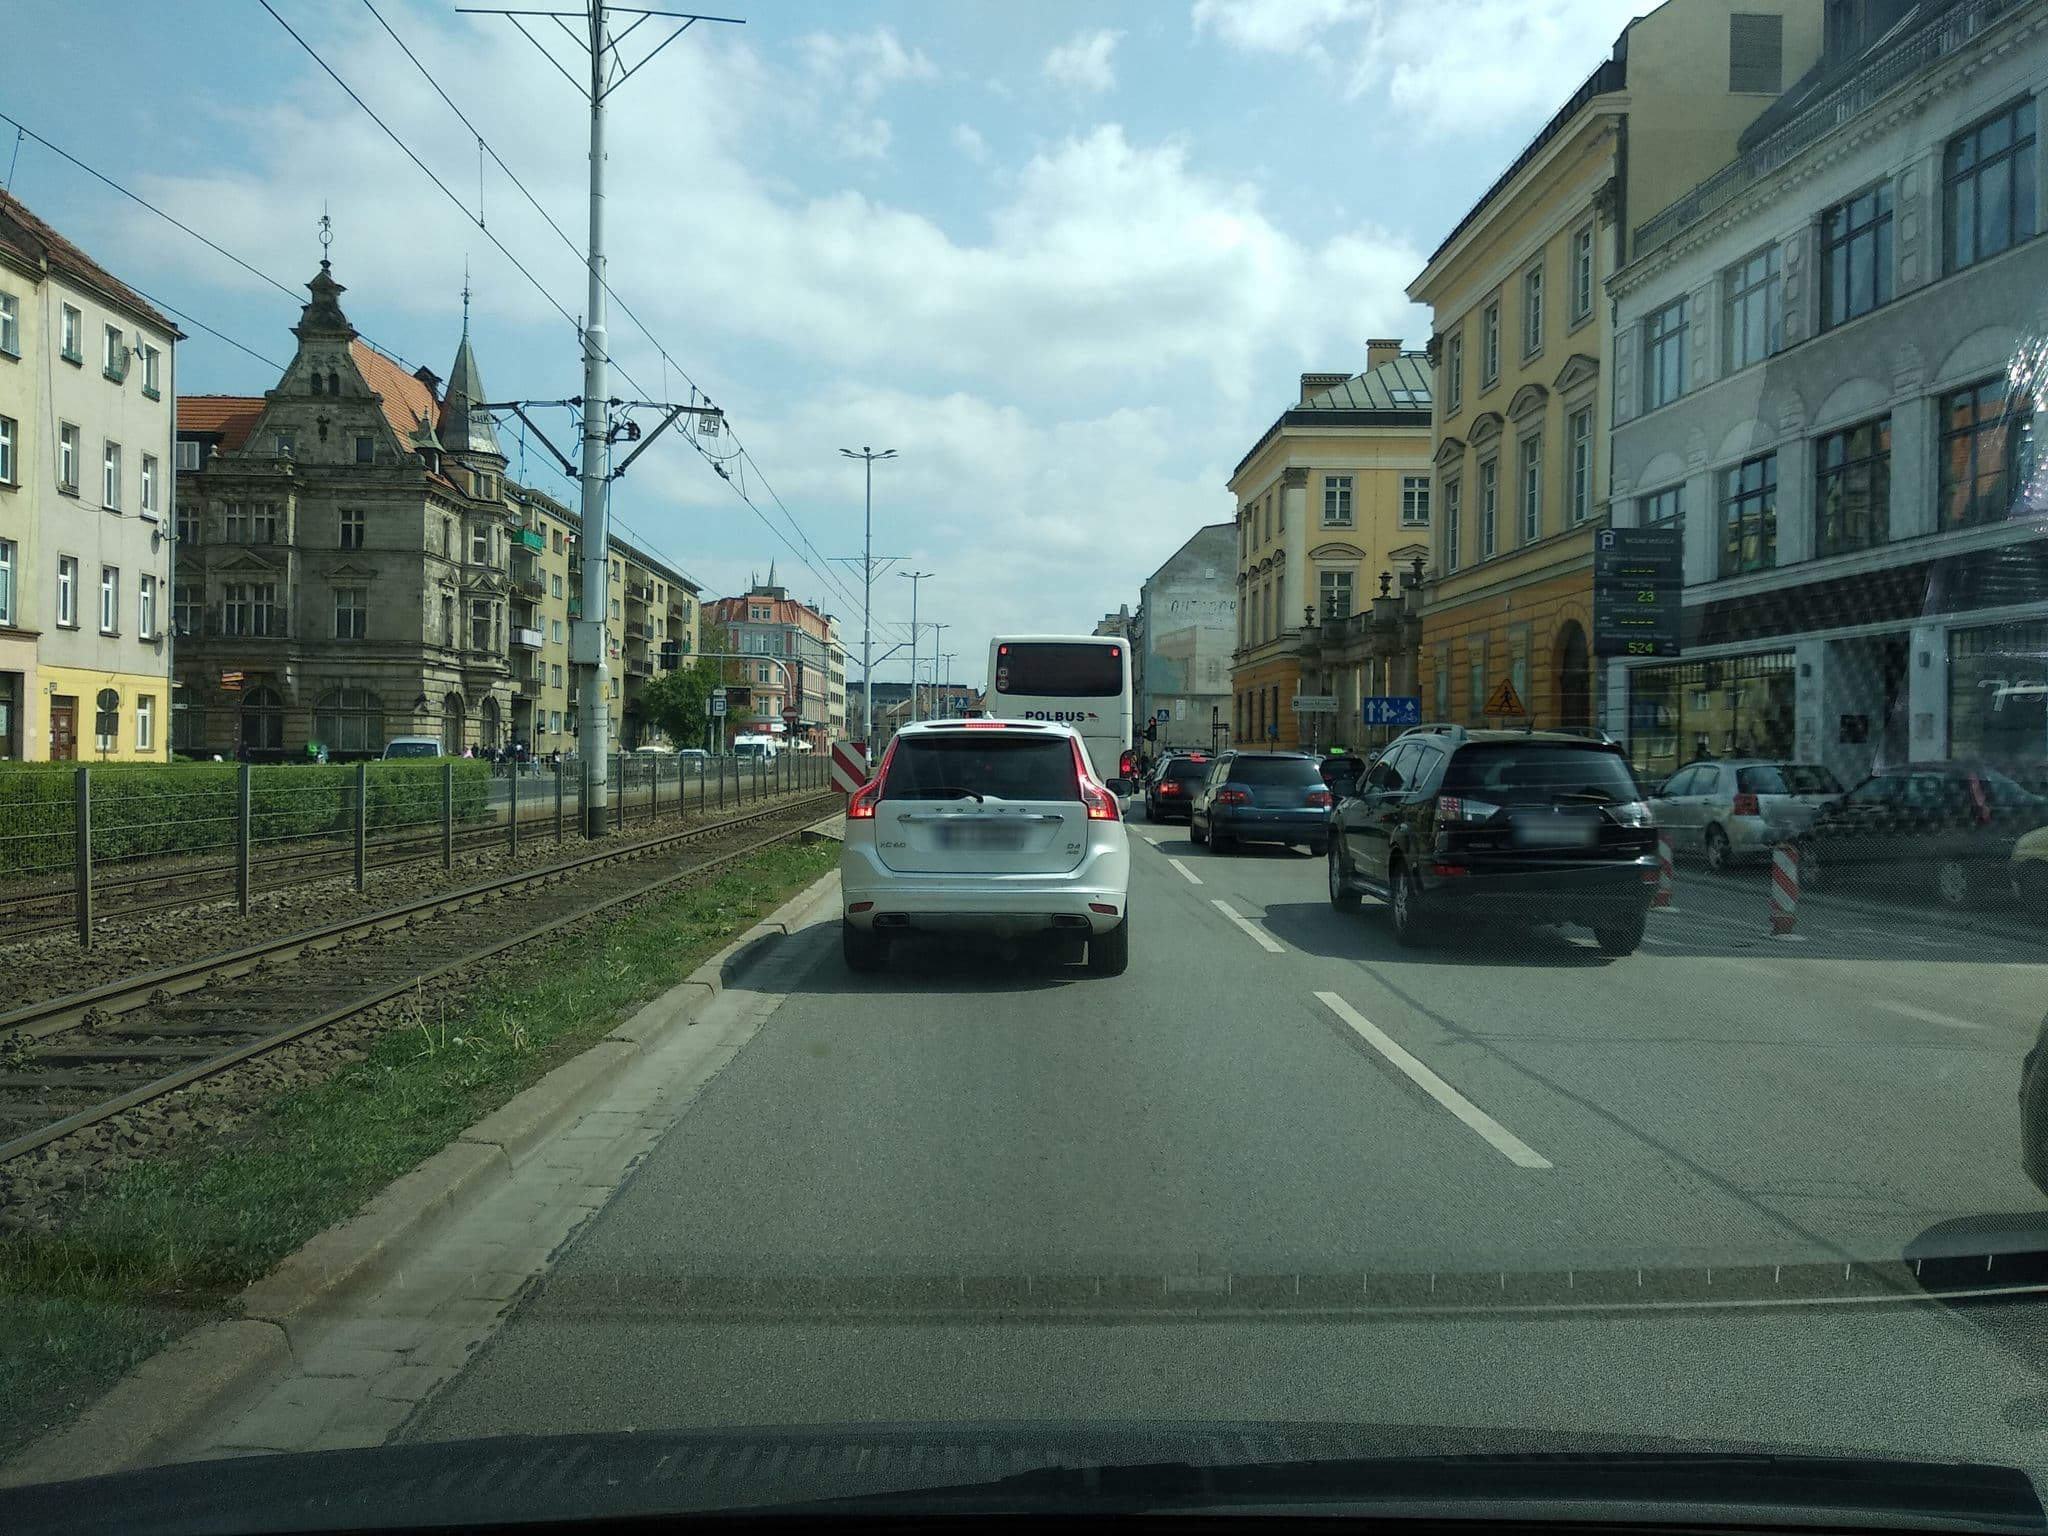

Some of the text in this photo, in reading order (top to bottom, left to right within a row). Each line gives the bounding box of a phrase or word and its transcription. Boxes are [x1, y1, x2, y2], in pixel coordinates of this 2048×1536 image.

[1637, 591, 1654, 602] 23
[1628, 642, 1654, 654] 524
[1025, 711, 1085, 722] POLBUS
